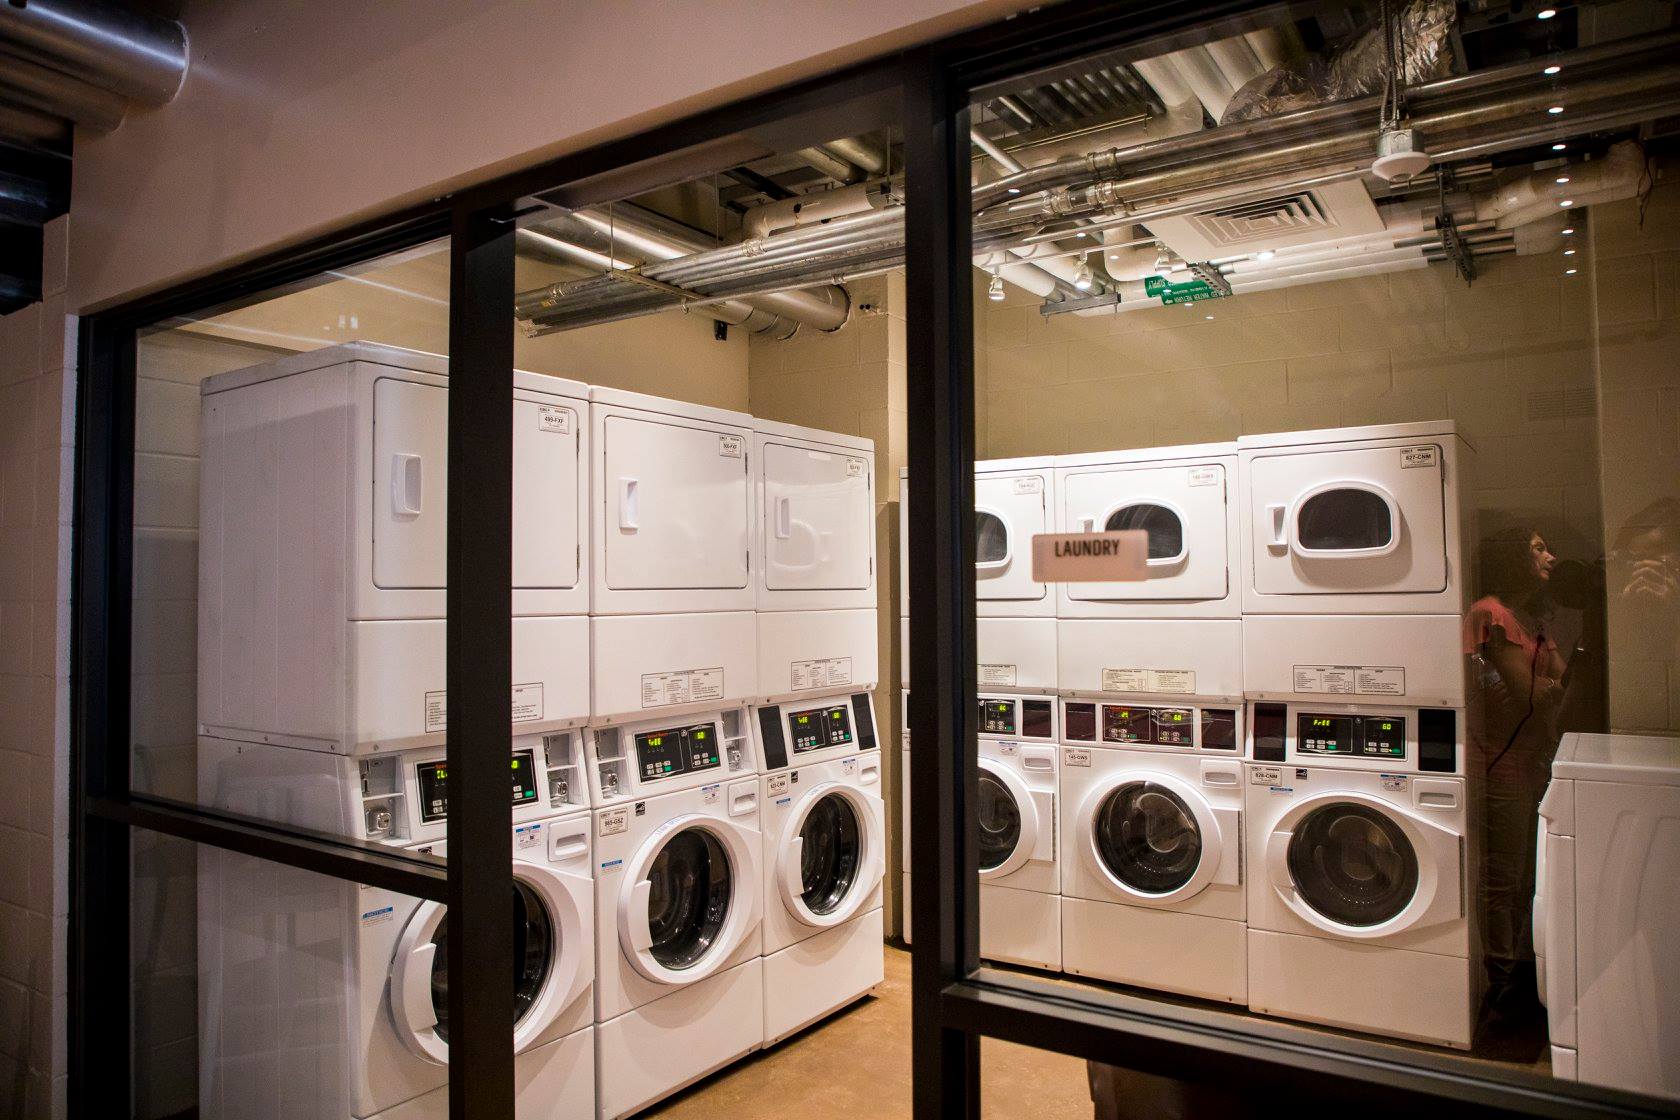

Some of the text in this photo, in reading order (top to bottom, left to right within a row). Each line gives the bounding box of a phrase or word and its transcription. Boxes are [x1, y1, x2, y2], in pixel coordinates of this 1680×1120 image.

[1148, 278, 1166, 290] SUPPLY
[1173, 296, 1192, 304] RETURN
[1055, 539, 1120, 557] LAUNDRY
